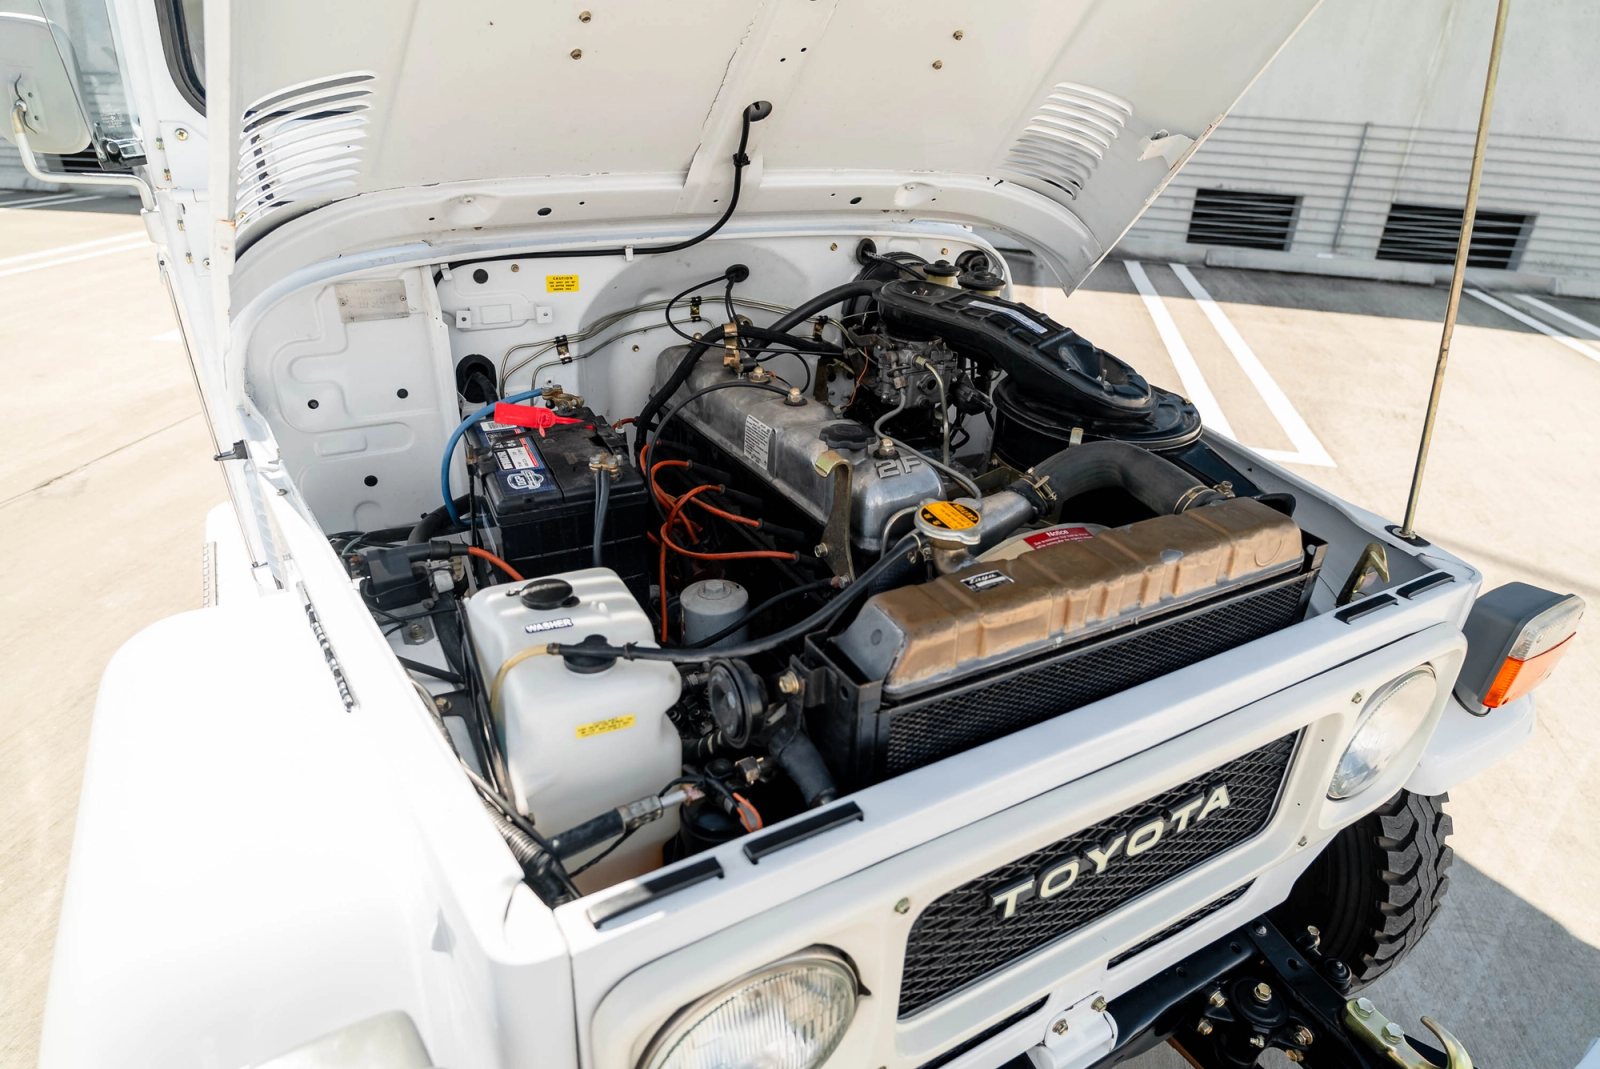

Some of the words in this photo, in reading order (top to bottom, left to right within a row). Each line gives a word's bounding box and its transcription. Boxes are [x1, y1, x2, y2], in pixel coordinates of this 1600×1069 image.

[874, 455, 922, 480] 2F
[1046, 529, 1070, 538] Notice
[525, 618, 574, 633] WASHER
[991, 782, 1231, 919] TOYOTA
